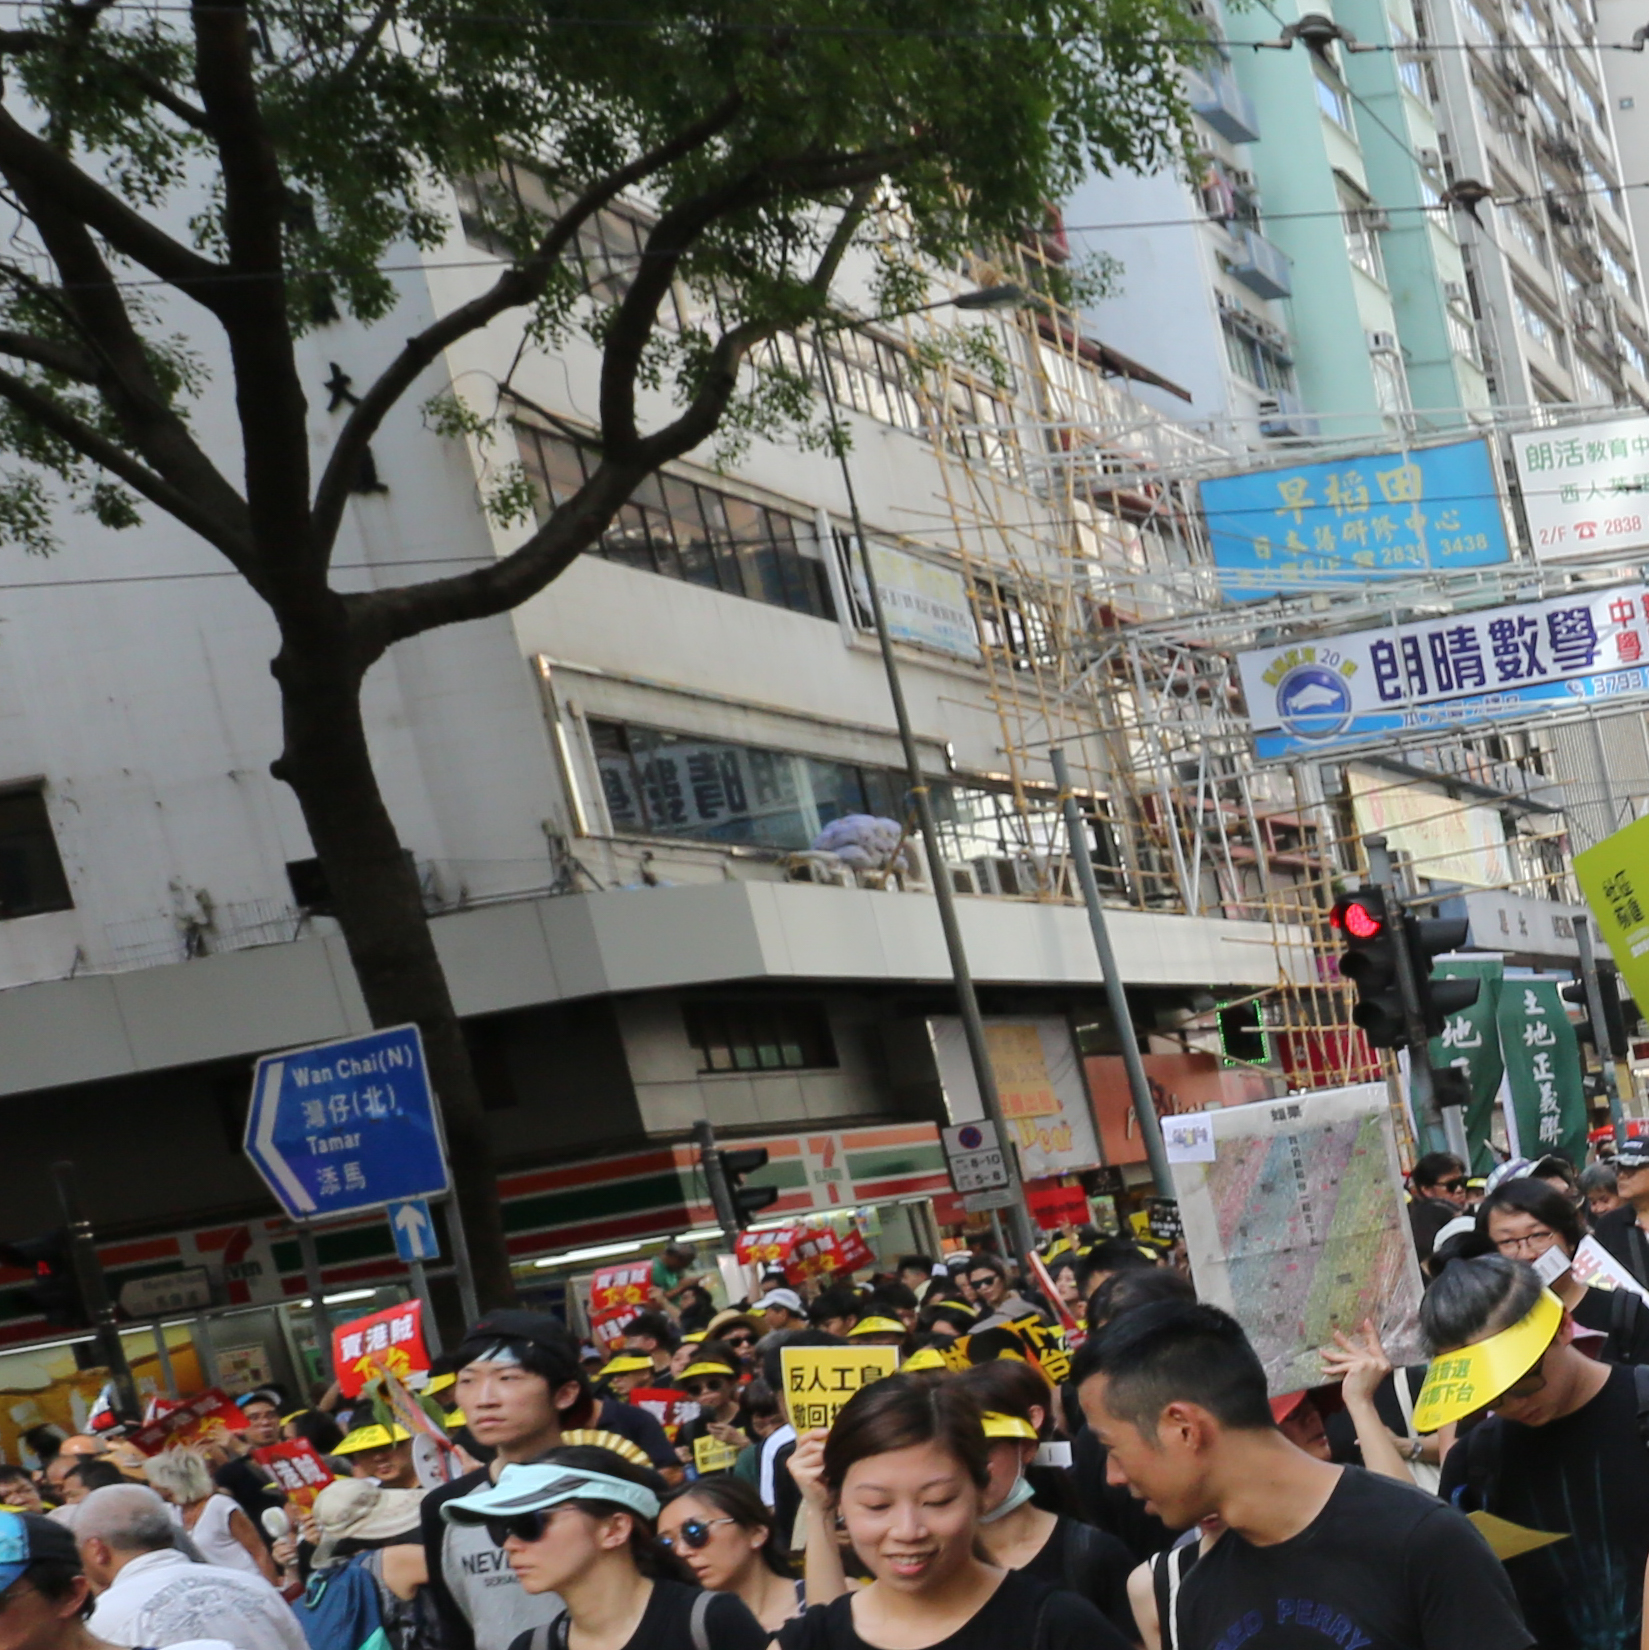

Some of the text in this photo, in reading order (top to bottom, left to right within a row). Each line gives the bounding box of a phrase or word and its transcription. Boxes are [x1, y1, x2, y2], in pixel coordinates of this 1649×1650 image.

[1440, 533, 1488, 556] 3438
[1539, 525, 1566, 546] 2/F
[1604, 515, 1643, 536] 2838
[1321, 648, 1340, 667] 20
[1369, 606, 1601, 702] 朗晴數學
[1593, 669, 1645, 697] 3793
[292, 1045, 413, 1087] Wan Chai(N)
[1513, 988, 1563, 1146] 土地正義聯
[303, 1084, 396, 1129] 灣仔(北)
[306, 1132, 362, 1156] Tamar
[316, 1161, 366, 1196] 添馬
